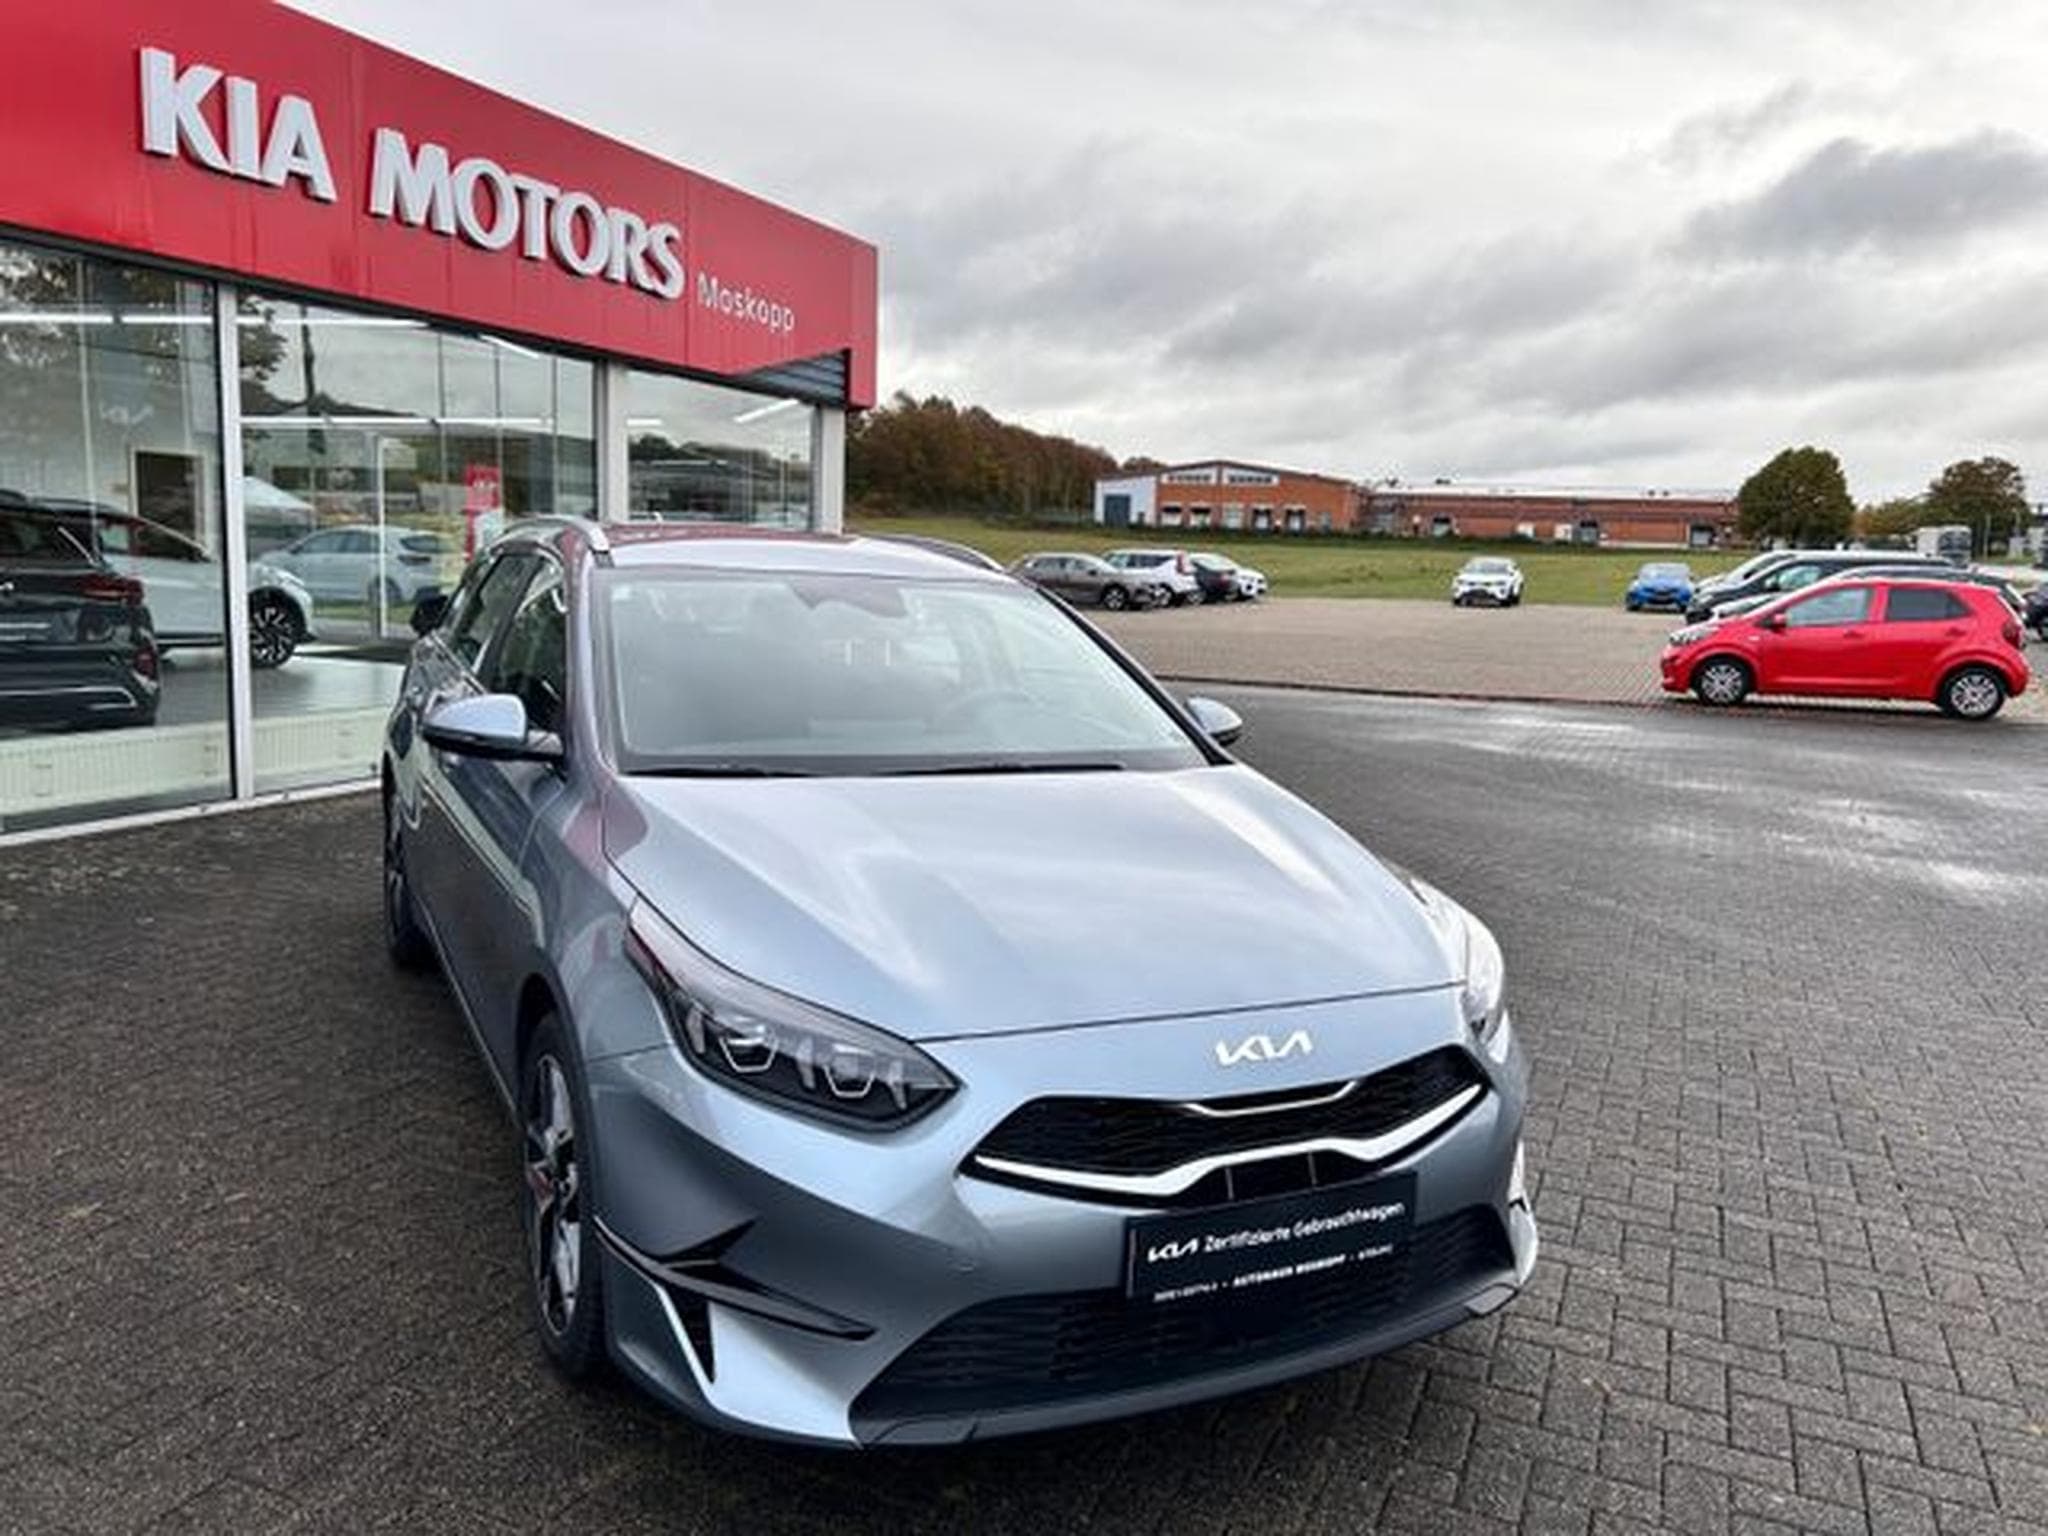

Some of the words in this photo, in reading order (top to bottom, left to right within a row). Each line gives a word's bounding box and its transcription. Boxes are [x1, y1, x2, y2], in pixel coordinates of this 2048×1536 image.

[141, 46, 336, 201] KIA
[370, 128, 684, 299] MOTORS
[697, 271, 795, 334] Moskopp
[1216, 1030, 1313, 1066] KIA
[1148, 1238, 1198, 1262] KIA
[1204, 1229, 1290, 1252] Zertifizierte
[1293, 1202, 1405, 1238] Gebrauchtwagen
